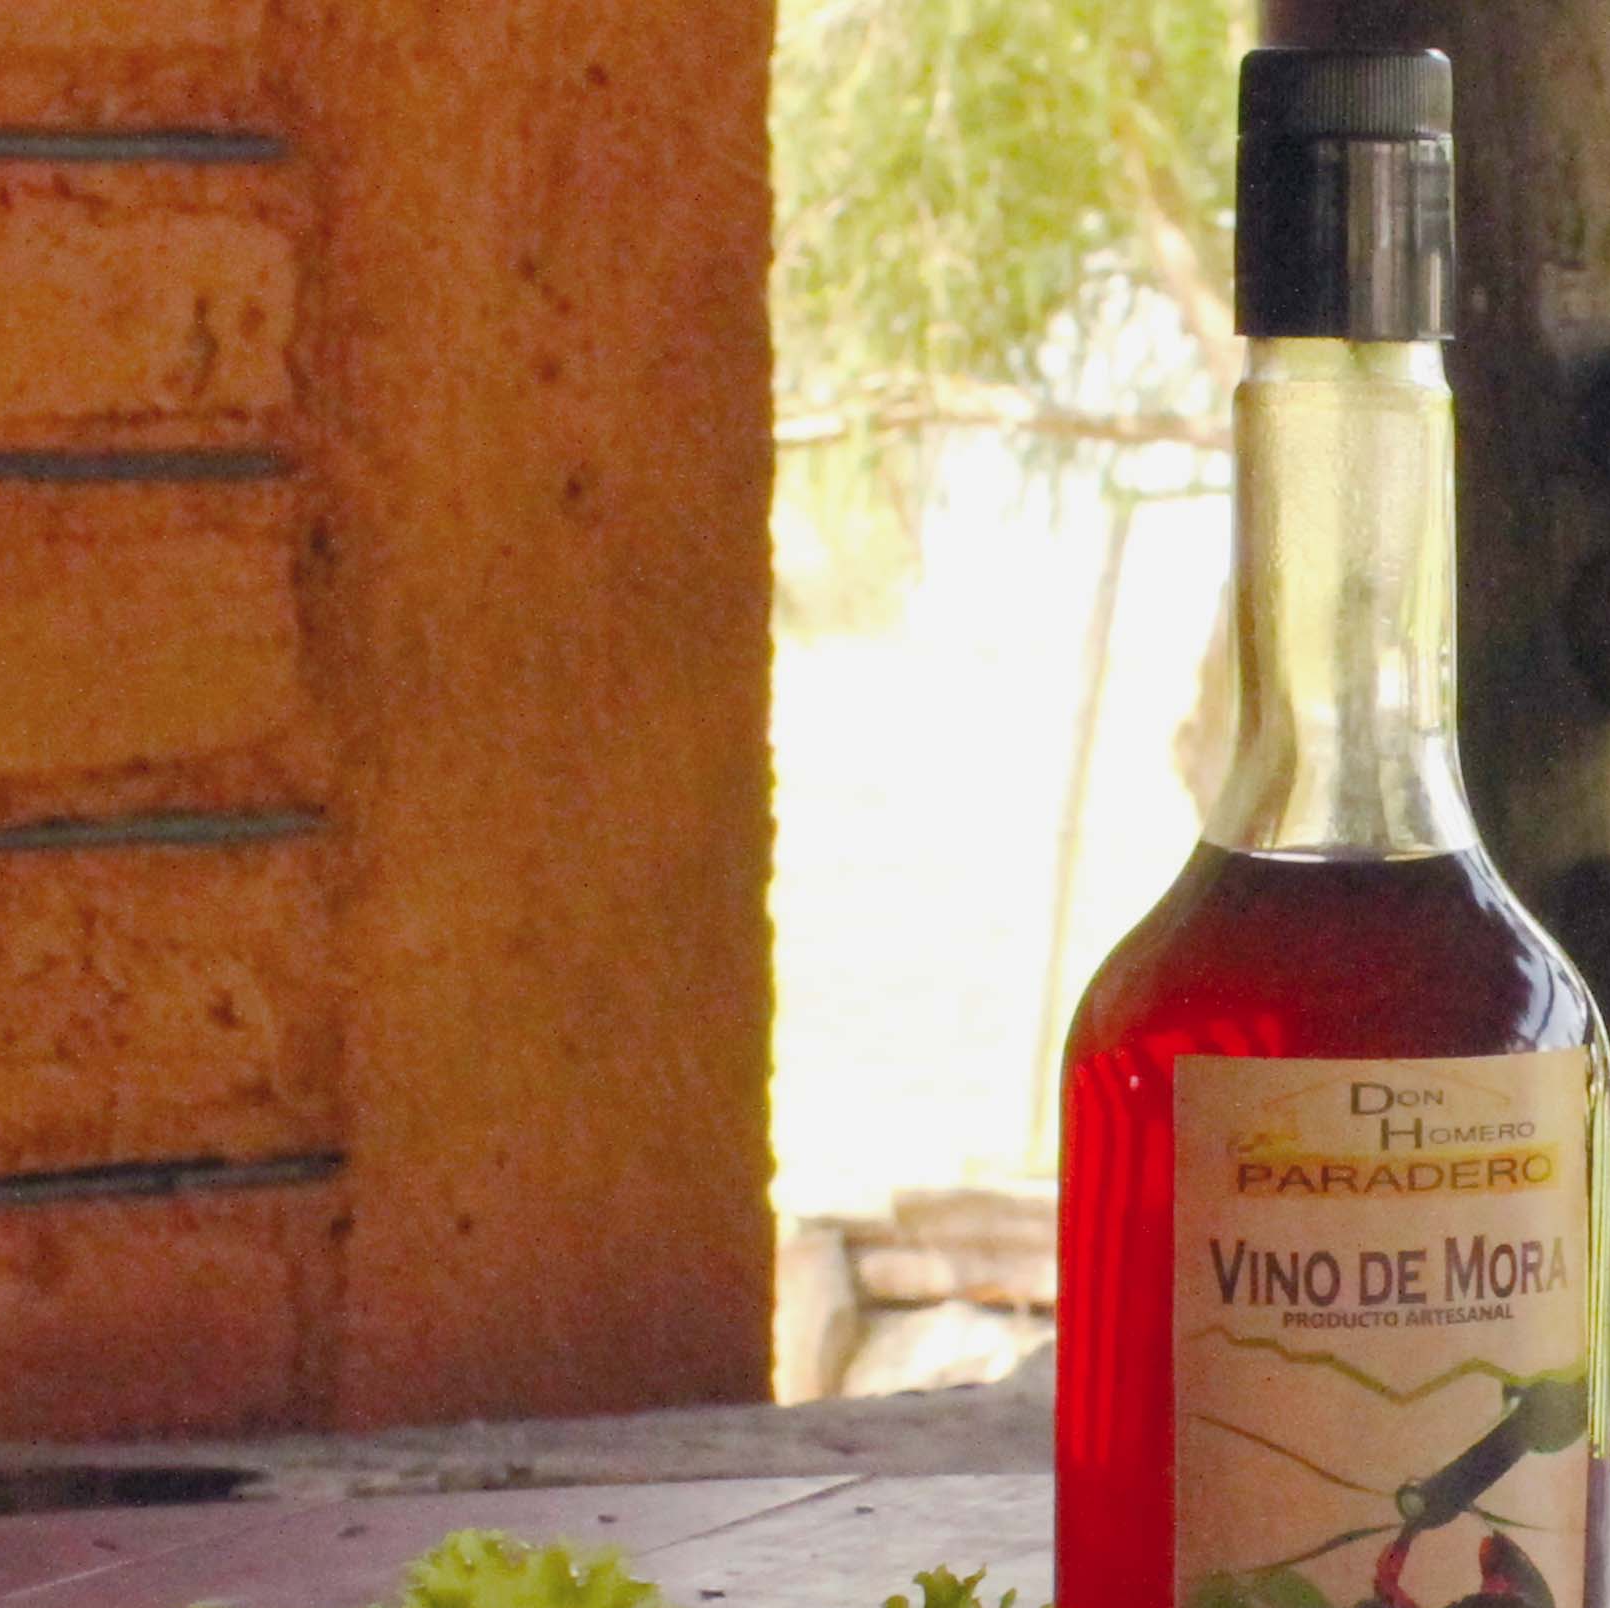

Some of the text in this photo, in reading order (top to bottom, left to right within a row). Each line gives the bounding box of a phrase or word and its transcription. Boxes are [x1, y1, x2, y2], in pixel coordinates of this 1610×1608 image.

[1237, 1154, 1553, 1193] PARADERO
[1209, 1234, 1569, 1307] VINO DE MORA
[1282, 1303, 1515, 1330] PRODUCTO ARTESANAL
